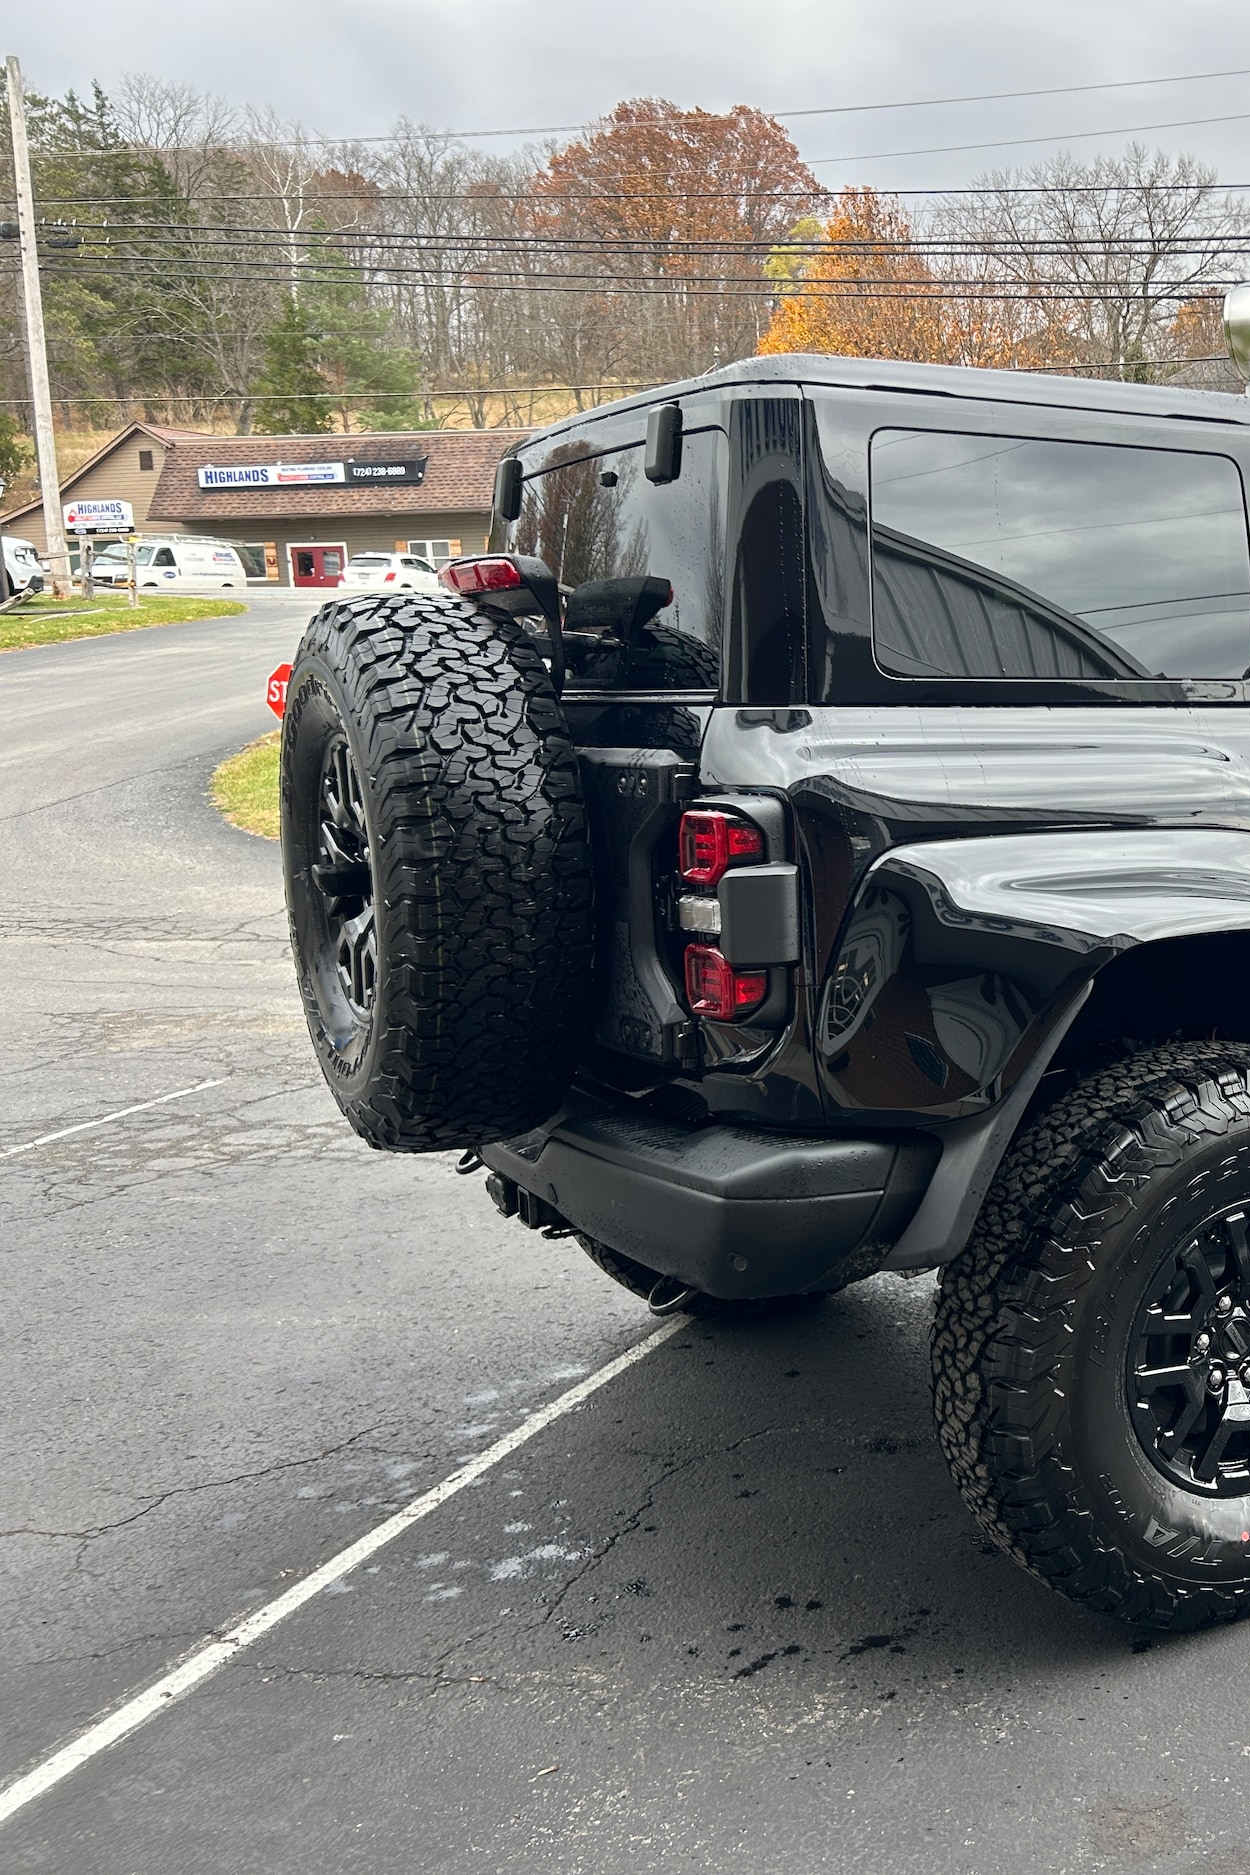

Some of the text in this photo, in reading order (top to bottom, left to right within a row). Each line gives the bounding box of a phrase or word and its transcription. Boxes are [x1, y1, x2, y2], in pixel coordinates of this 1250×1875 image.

[204, 469, 269, 484] HIGHLANDS
[77, 503, 122, 514] HIGHLANDS
[269, 680, 288, 702] ST
